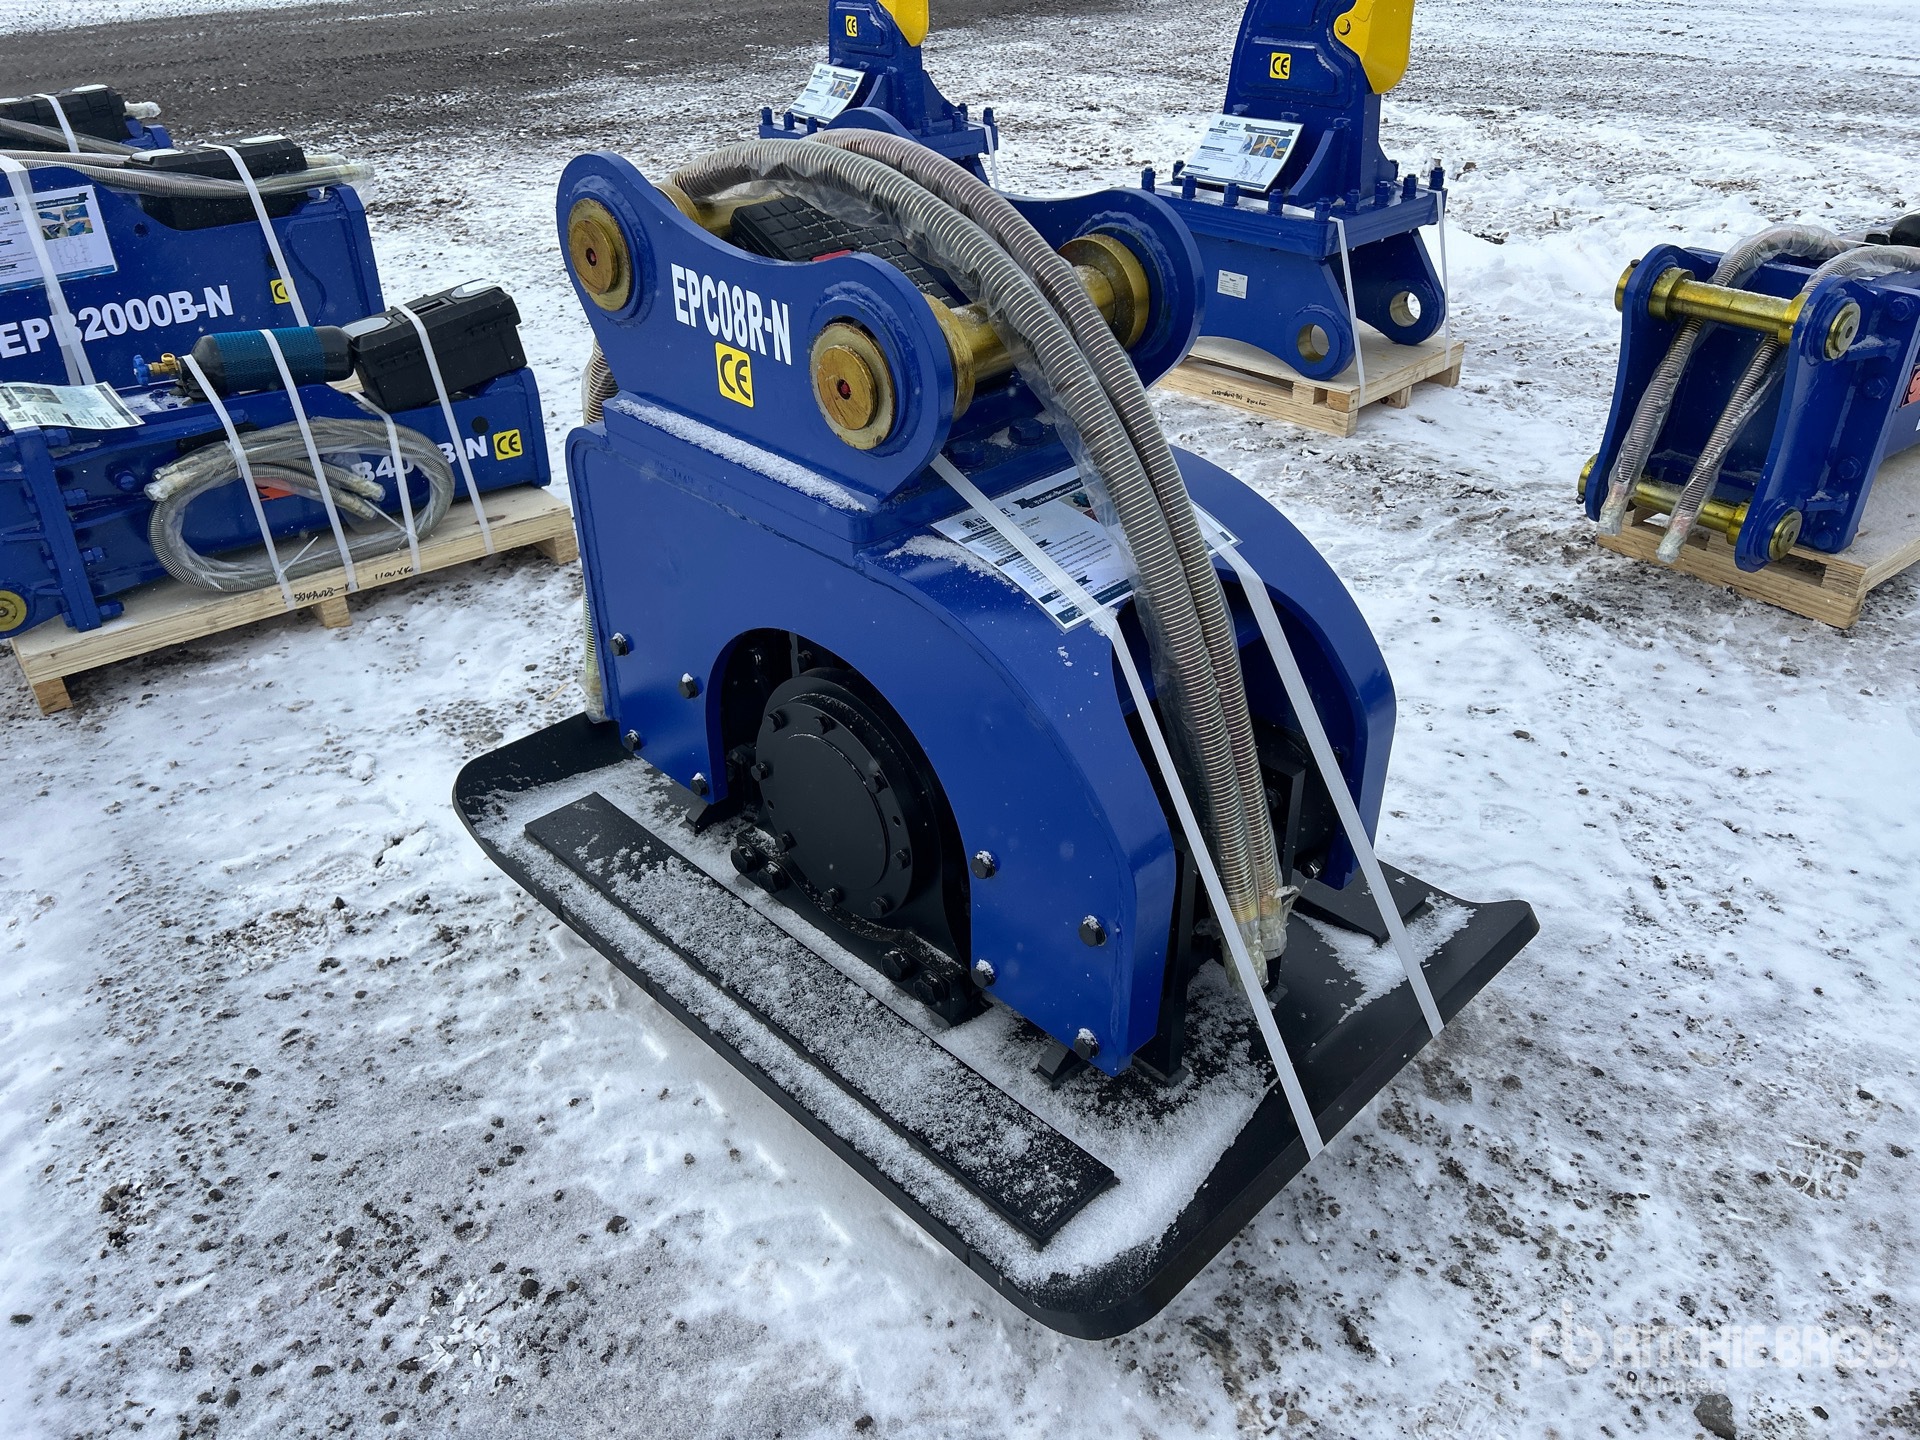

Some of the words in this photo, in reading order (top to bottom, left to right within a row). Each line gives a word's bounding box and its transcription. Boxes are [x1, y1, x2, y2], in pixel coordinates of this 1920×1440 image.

[847, 18, 857, 34] CE
[1272, 56, 1289, 76] CE
[671, 262, 792, 366] EPC08R-N
[719, 353, 751, 401] CE
[496, 433, 521, 455] CE
